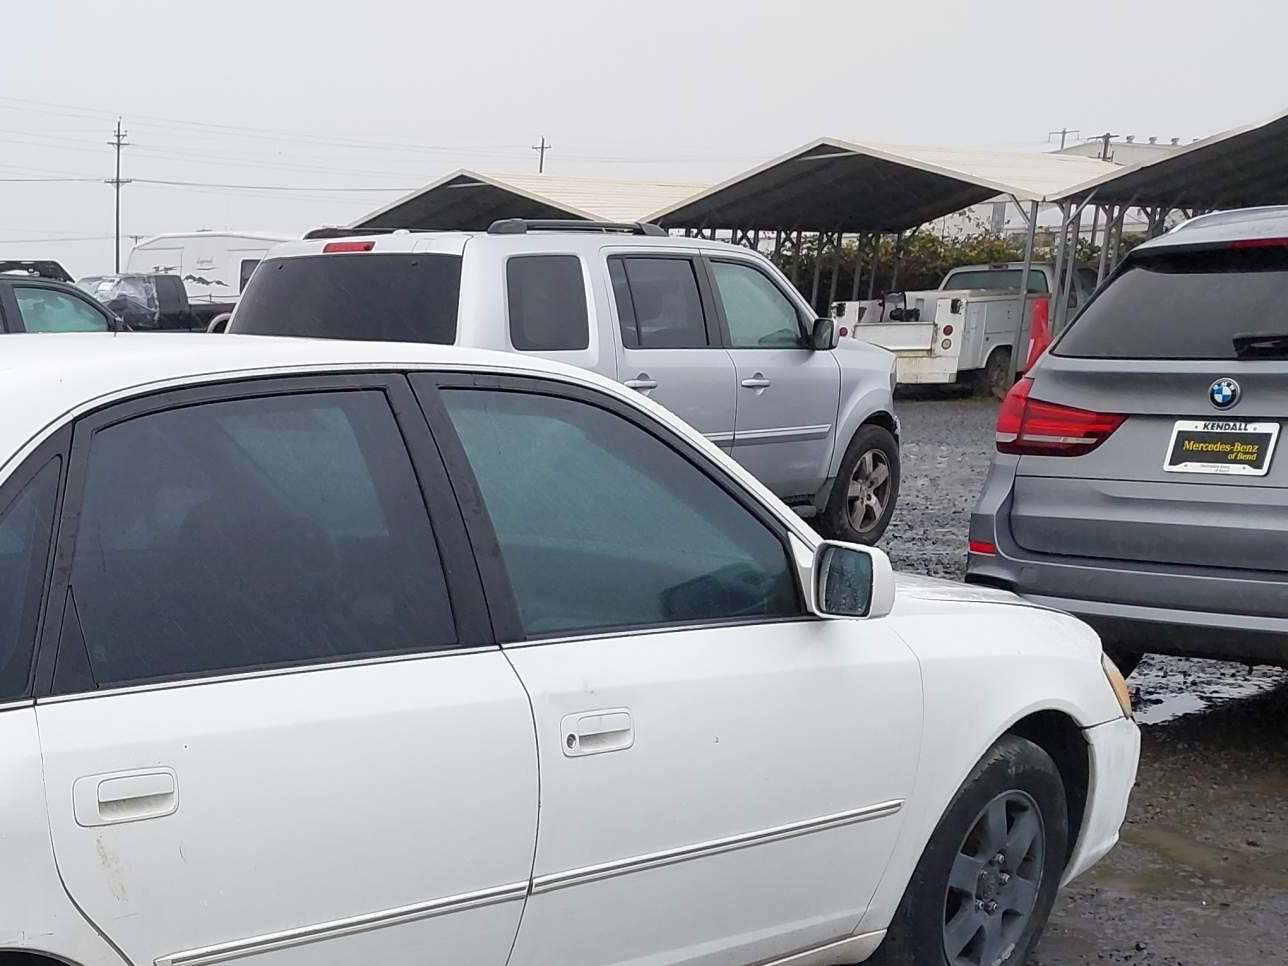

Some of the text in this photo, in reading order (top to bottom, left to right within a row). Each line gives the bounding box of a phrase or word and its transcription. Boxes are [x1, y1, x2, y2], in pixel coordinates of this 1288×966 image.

[1202, 422, 1249, 432] KENDALL
[1183, 440, 1259, 453] Mercedes-Benz
[1237, 452, 1257, 461] Bend
